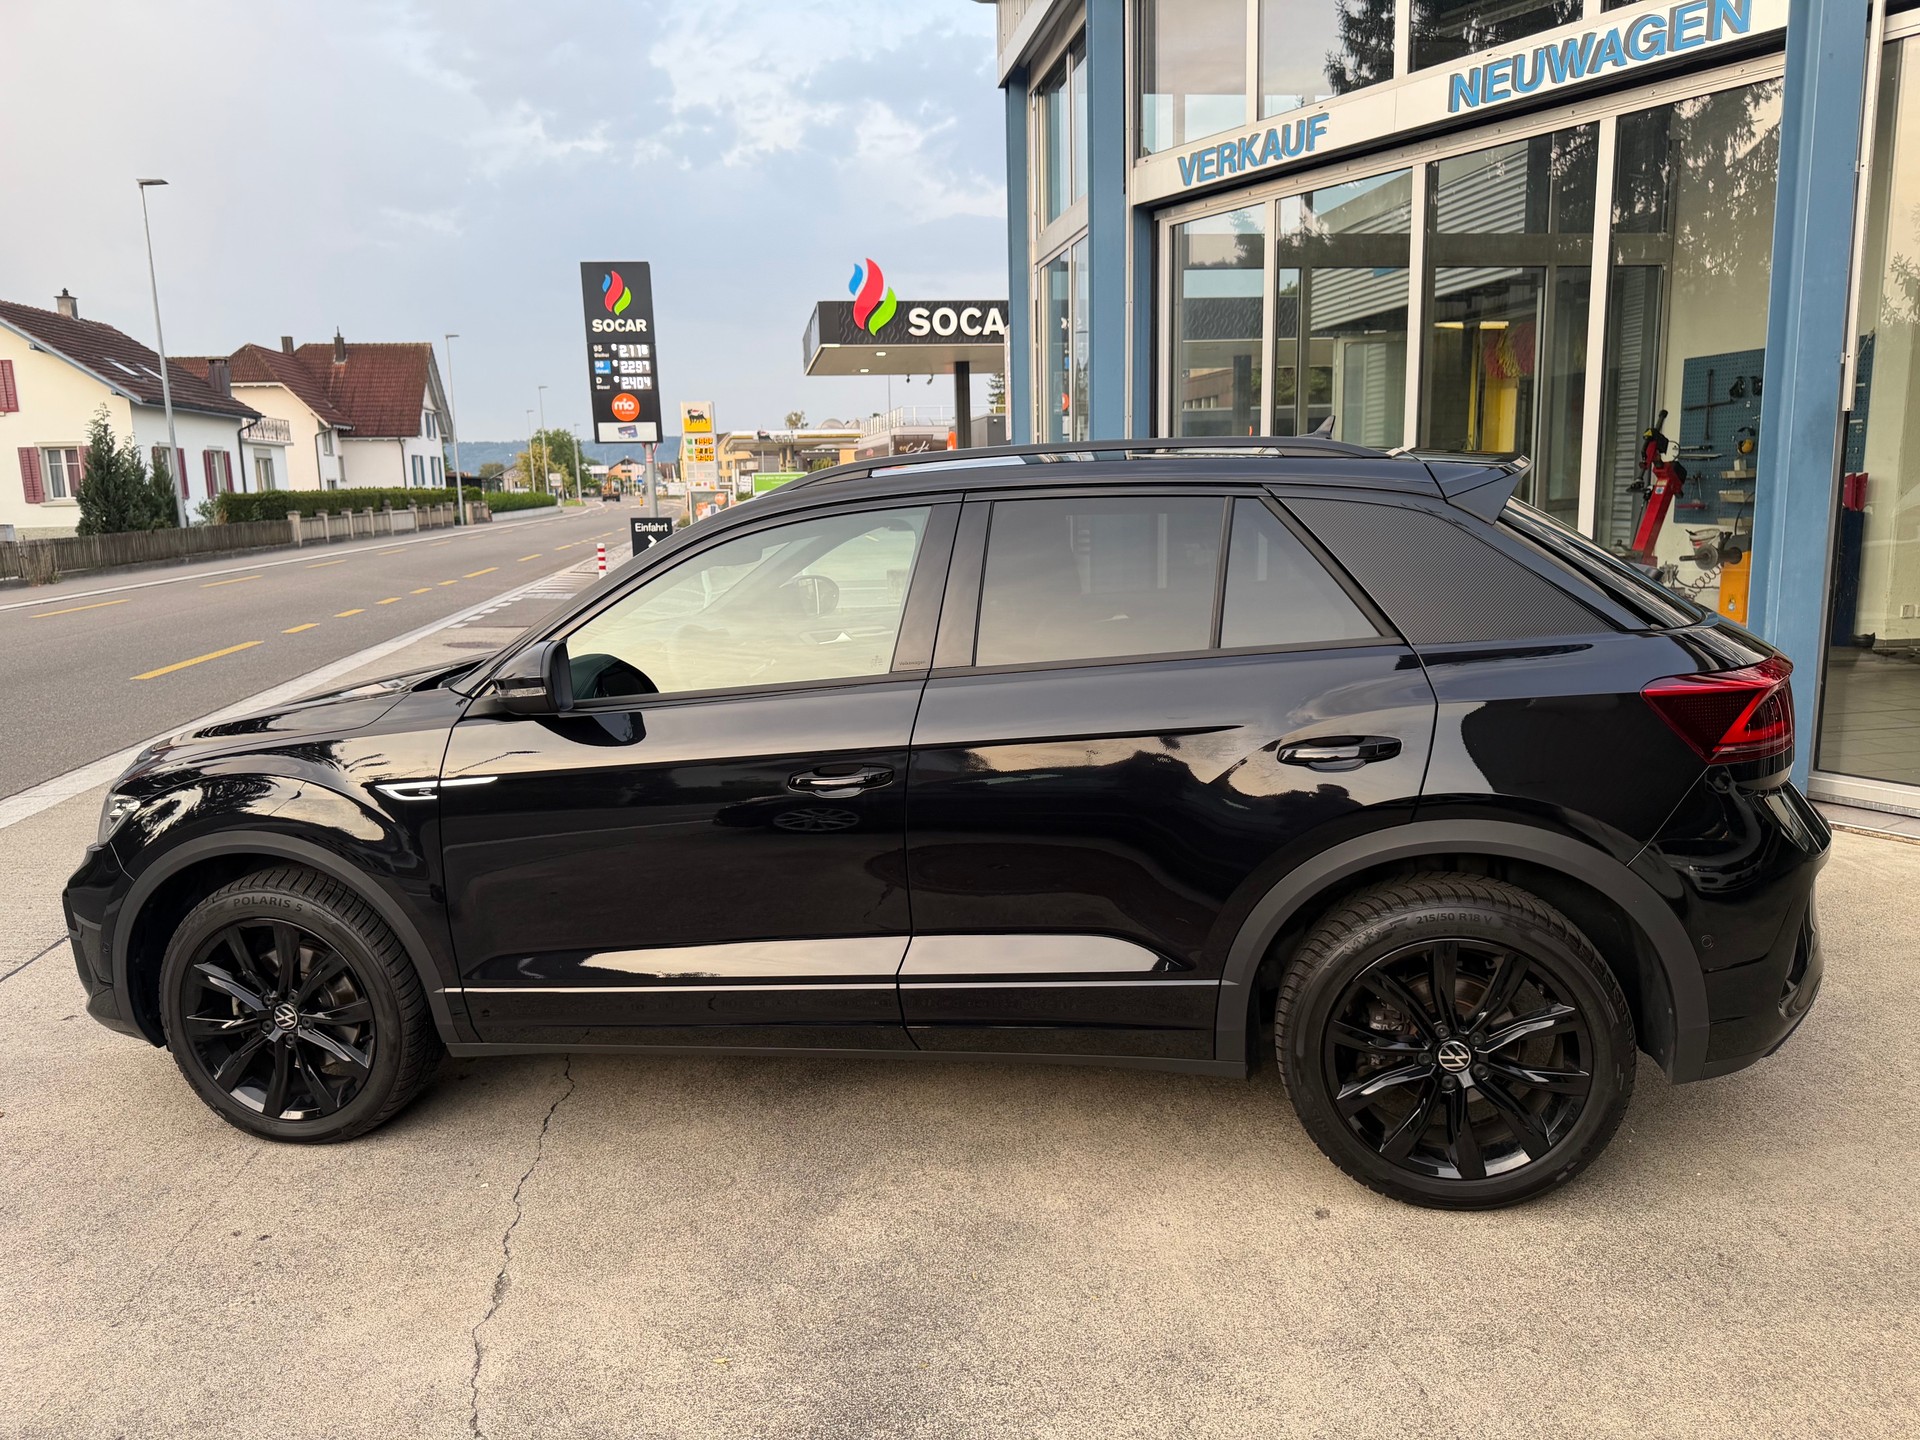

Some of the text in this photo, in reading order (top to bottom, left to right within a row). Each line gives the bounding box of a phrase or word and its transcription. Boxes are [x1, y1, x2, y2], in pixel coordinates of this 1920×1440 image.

[1448, 0, 1753, 113] NEUWAGEN
[1177, 113, 1330, 187] VERKAUF
[592, 319, 647, 333] SOCAR
[614, 398, 635, 410] mio
[634, 522, 669, 533] Einfahrt
[233, 896, 291, 909] POLARIS
[1416, 912, 1493, 925] 215/50 R18 V
